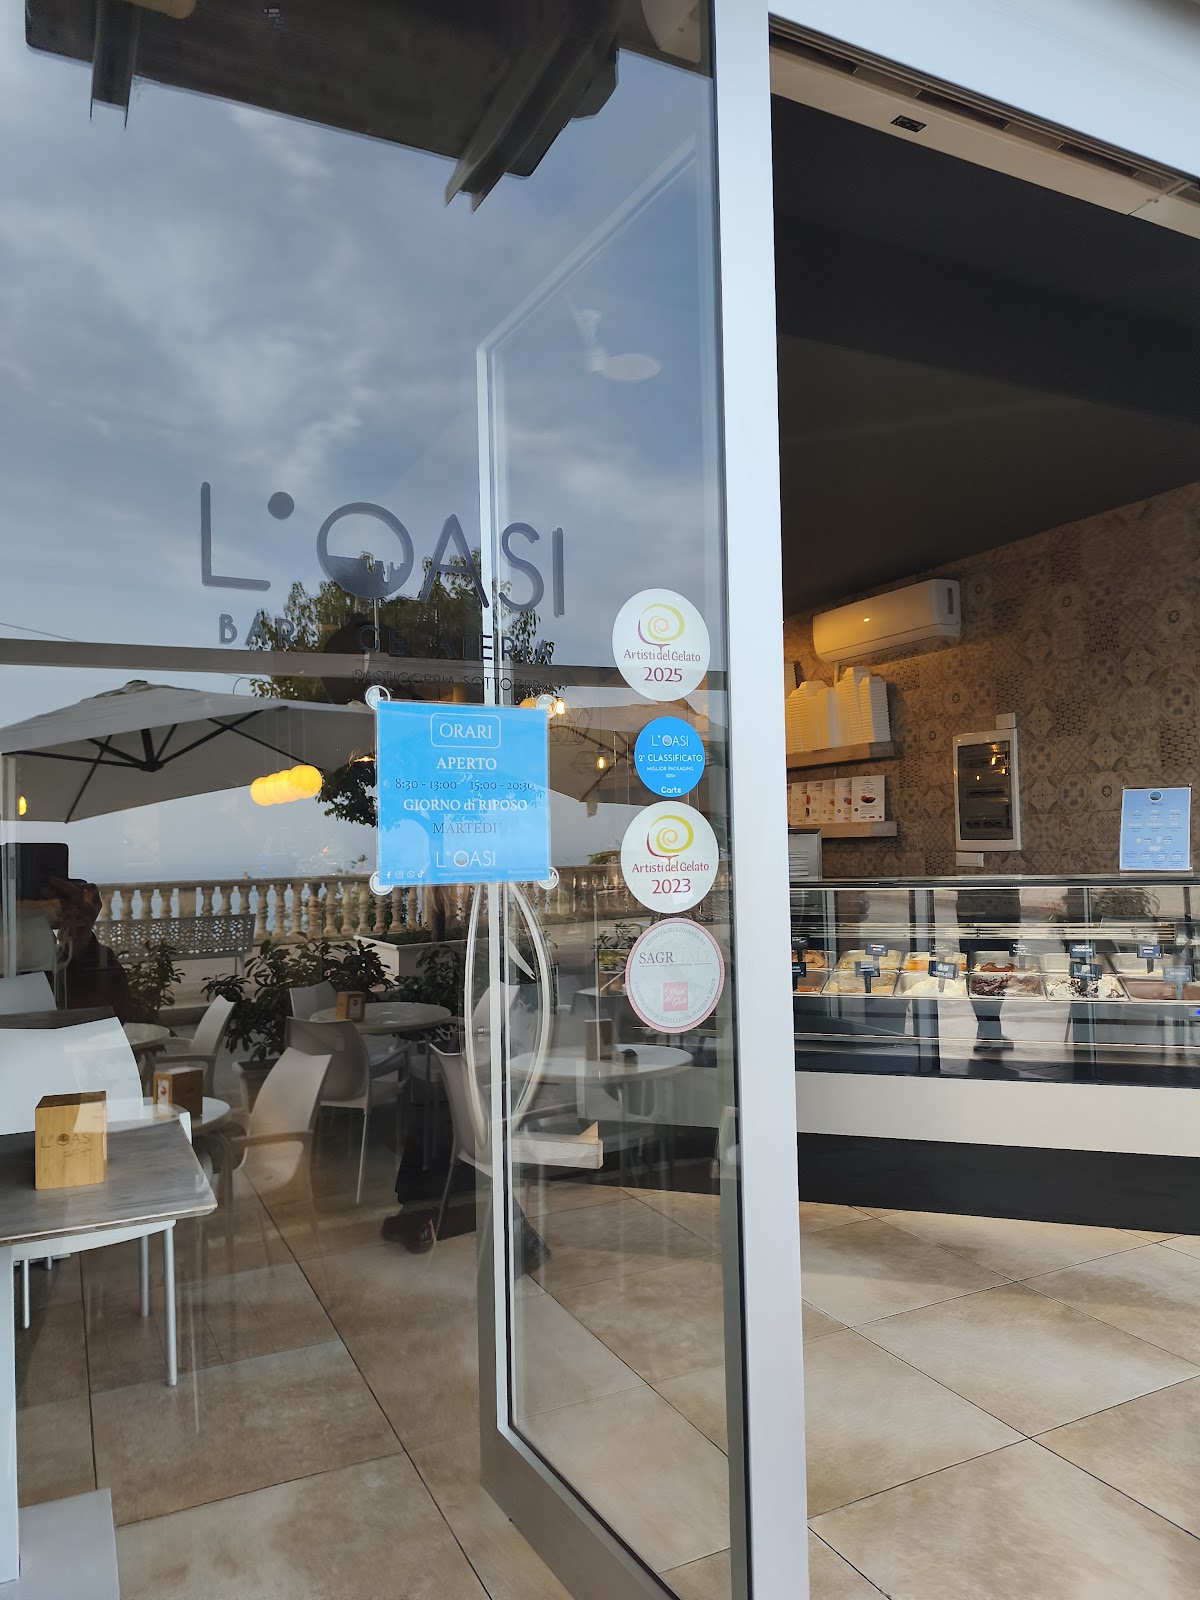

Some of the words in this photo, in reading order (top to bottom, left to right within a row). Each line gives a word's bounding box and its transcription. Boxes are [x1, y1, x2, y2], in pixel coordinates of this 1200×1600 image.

[218, 612, 296, 650] BAR
[357, 624, 555, 665] GELATERIA
[624, 649, 656, 661] Artisti
[657, 650, 670, 661] del
[671, 650, 701, 662] Gelato
[354, 668, 455, 687] PASTICCERIA
[643, 667, 683, 683] 2025
[439, 723, 492, 740] ORARI
[436, 756, 497, 771] APERTO
[647, 753, 703, 762] CLASSIFICATO
[395, 778, 419, 790] 8:30
[429, 780, 457, 790] 13:00
[470, 780, 497, 790] 15:00
[506, 780, 535, 791] 20:30
[661, 785, 682, 794] Carte
[403, 799, 461, 812] GIORNO
[463, 799, 475, 812] di
[477, 799, 529, 812] RIPOSO
[631, 862, 664, 873] Artisti
[665, 860, 679, 872] del
[680, 860, 710, 872] Gelato
[651, 878, 691, 895] 2023
